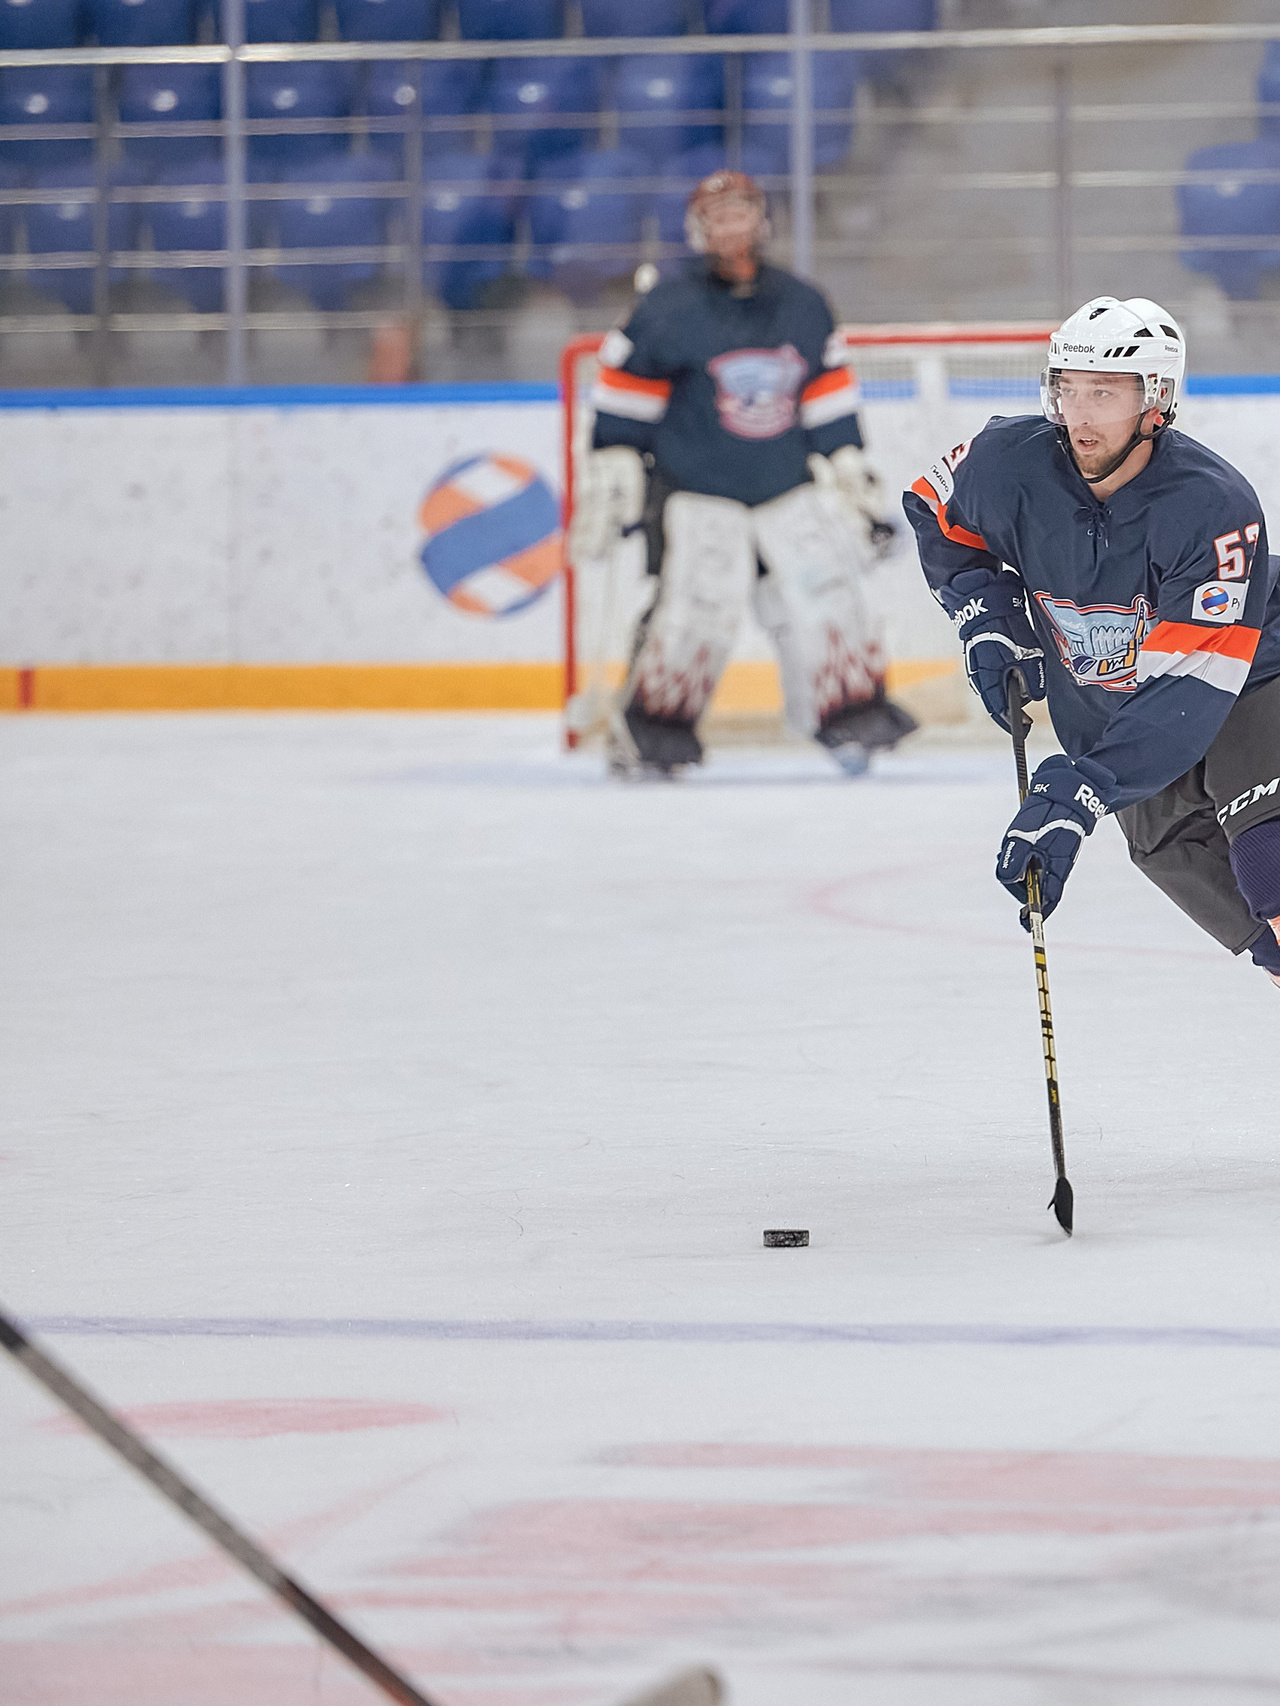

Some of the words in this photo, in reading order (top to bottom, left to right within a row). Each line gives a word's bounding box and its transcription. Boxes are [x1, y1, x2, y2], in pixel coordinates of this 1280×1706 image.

[1062, 342, 1096, 354] Reebok
[1216, 776, 1280, 827] CCM
[1002, 841, 1016, 869] Reebok
